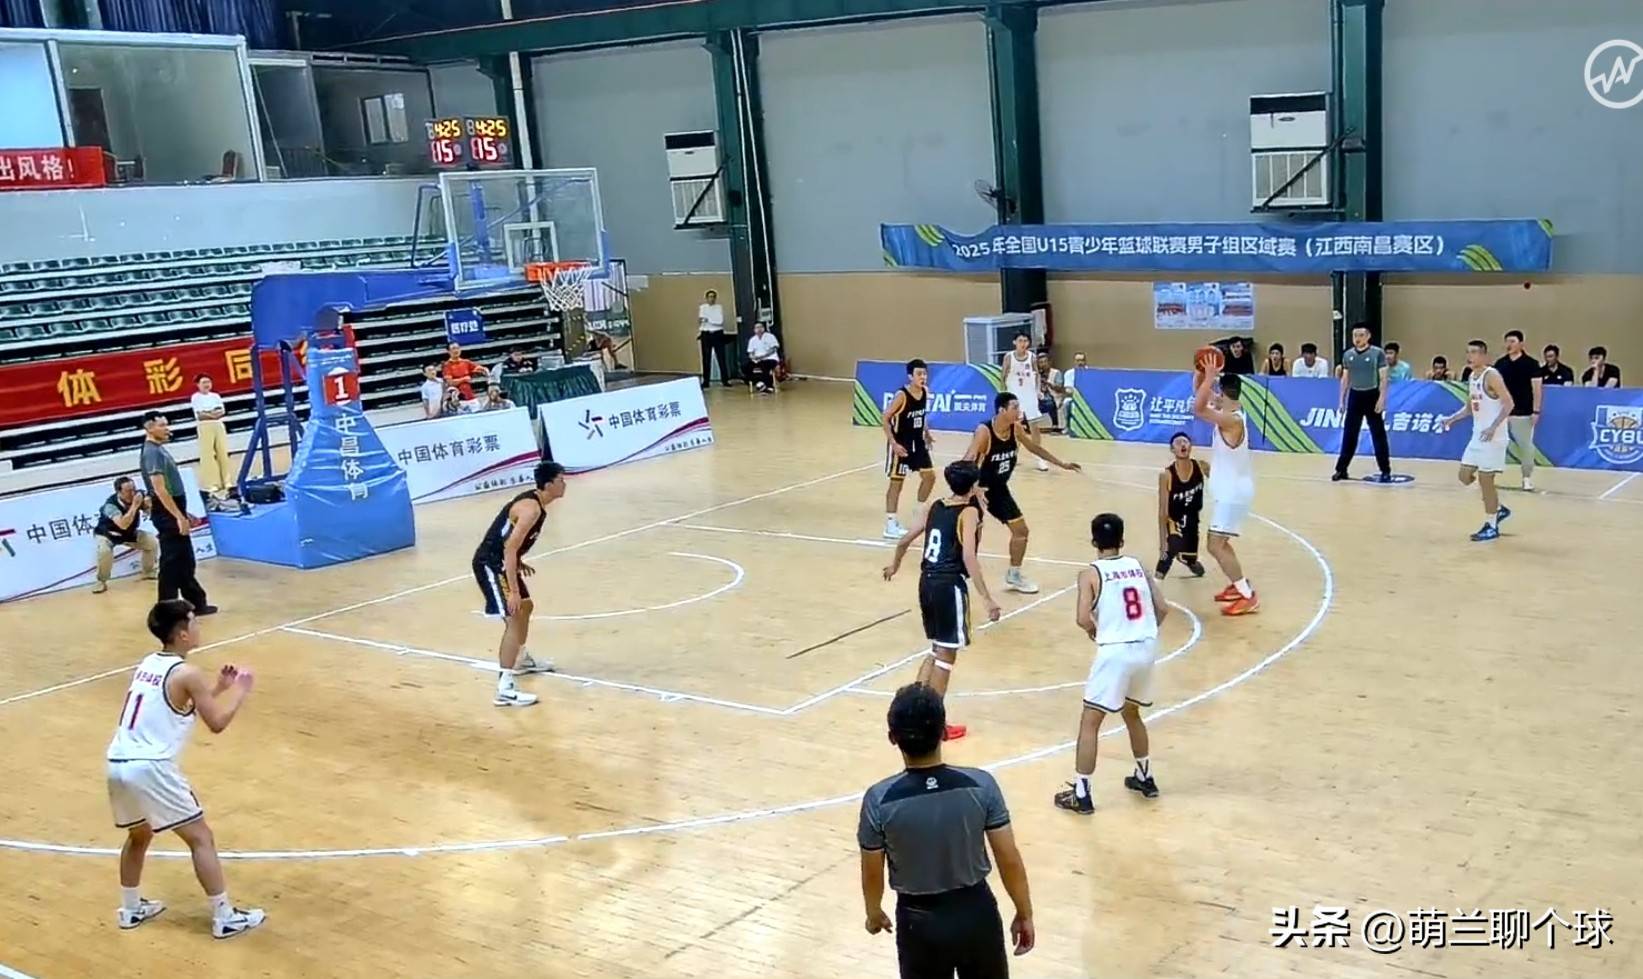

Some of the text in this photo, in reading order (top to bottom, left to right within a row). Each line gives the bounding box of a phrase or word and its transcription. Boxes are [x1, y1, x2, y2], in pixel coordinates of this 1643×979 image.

[334, 376, 349, 400] 1
[608, 402, 682, 430] 中国体育彩票
[398, 434, 500, 465] 中国体育彩票
[925, 528, 941, 563] 8
[1122, 586, 1142, 620] 8
